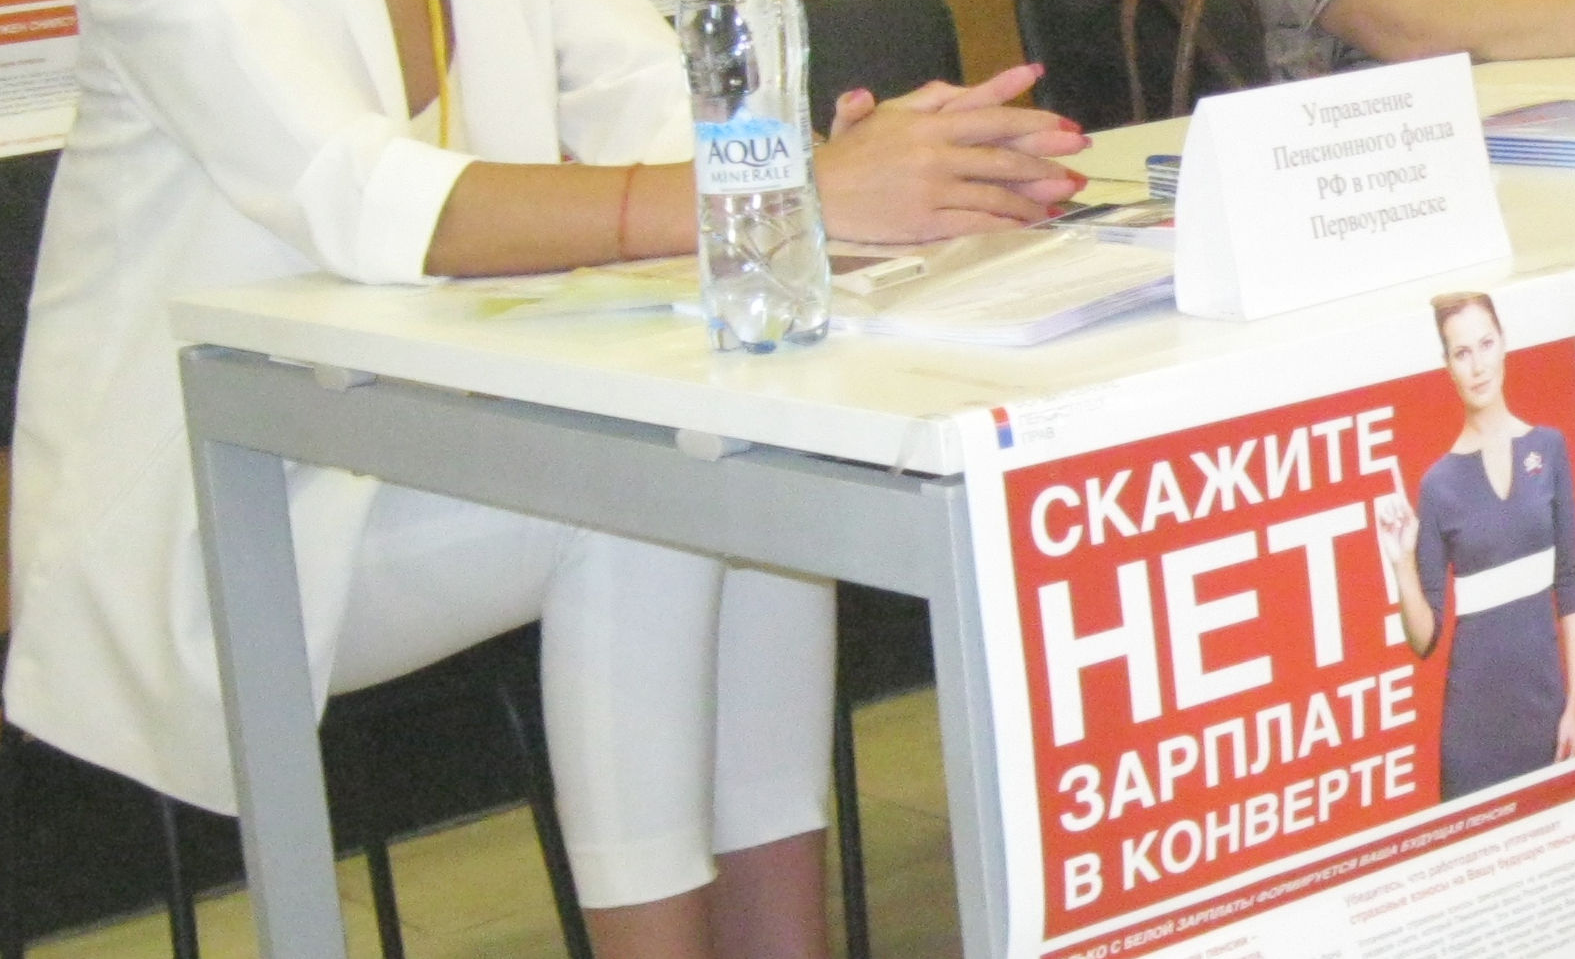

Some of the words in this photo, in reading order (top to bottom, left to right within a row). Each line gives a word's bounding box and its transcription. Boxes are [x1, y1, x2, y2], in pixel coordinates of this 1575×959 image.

[1302, 92, 1414, 128] Управление
[708, 136, 789, 168] AQUA
[1272, 132, 1397, 170] Пенсионного
[1400, 121, 1455, 151] фонда
[711, 167, 791, 183] MINERALE
[1317, 173, 1347, 199] РФ
[1352, 177, 1364, 193] в
[1367, 163, 1428, 192] городе
[1310, 195, 1448, 240] Первоуральске
[1030, 405, 1398, 557] СКАЖИТЕ
[1037, 491, 1408, 748] НЕТ!
[1058, 664, 1417, 832] ЗАРПЛАТЕ
[1063, 852, 1103, 912] В
[1122, 744, 1416, 891] КОНВЕРТЕ
[1123, 920, 1175, 950] БЕЛОЙ
[1175, 895, 1256, 932] ЗАРПЛАТЫ
[1256, 858, 1358, 903] ФОРМИРУЕТСЯ
[1358, 844, 1399, 869] ВАША
[1399, 820, 1465, 853] БУДУЩАЯ
[1465, 802, 1518, 830] ПЕНСИЯ
